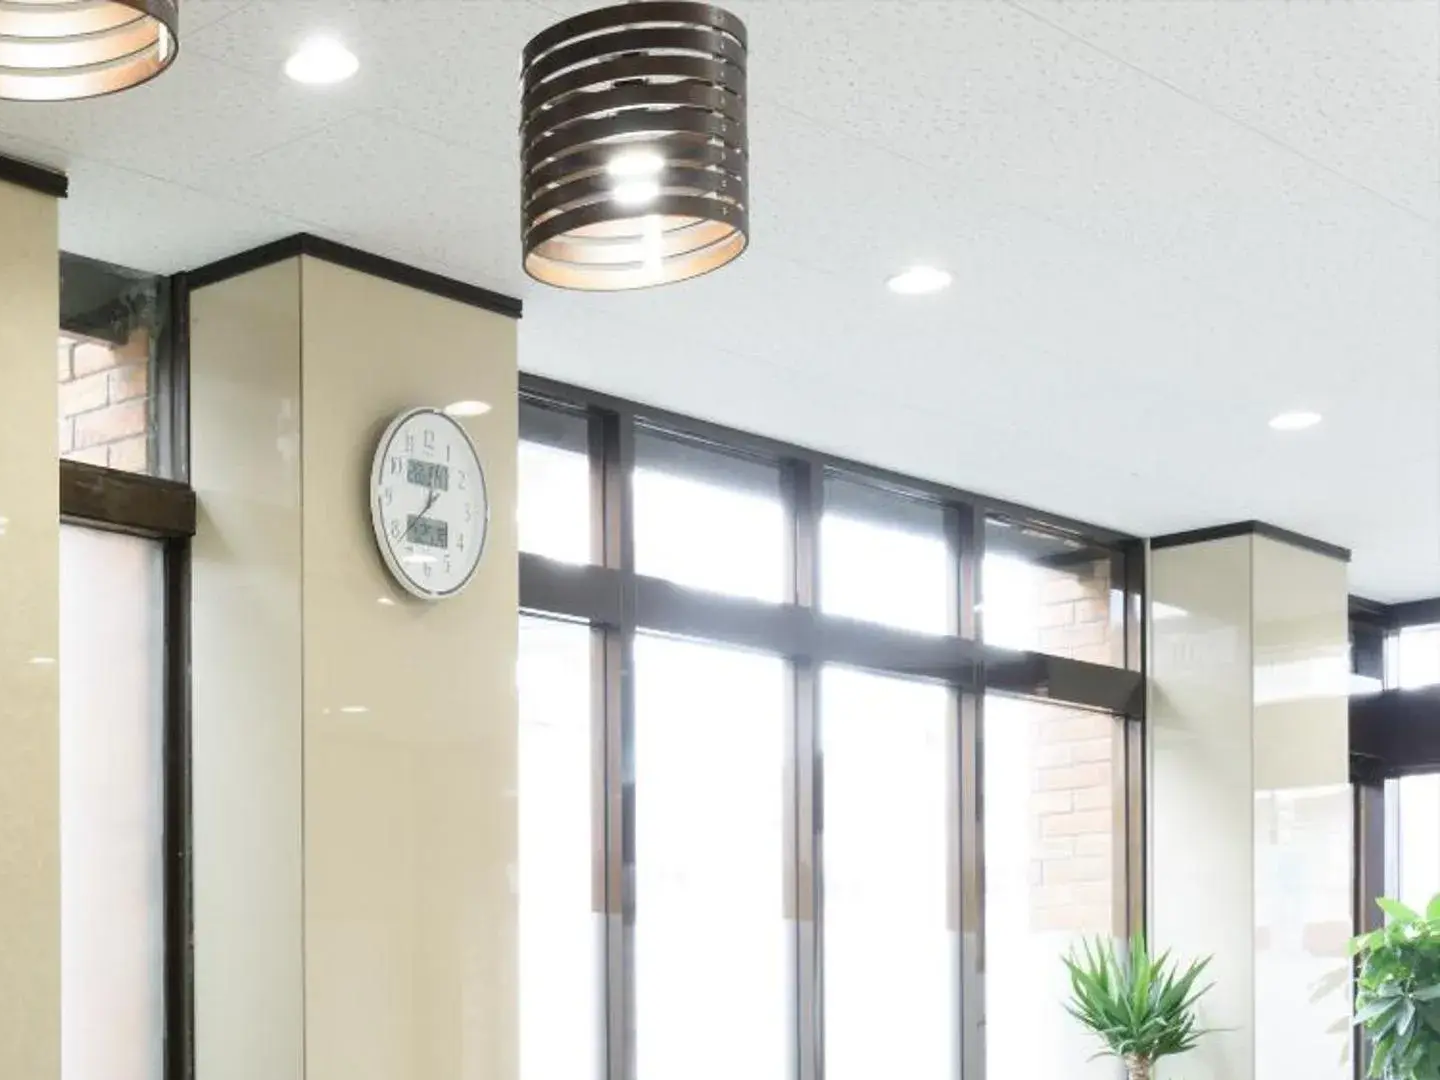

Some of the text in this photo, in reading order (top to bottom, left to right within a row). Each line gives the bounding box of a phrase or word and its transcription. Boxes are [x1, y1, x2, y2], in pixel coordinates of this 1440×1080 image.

[405, 431, 415, 453] 11
[424, 429, 435, 450] 12
[390, 456, 403, 475] 10
[457, 470, 466, 490] 2
[384, 487, 393, 506] 9
[464, 502, 472, 523] 3
[390, 519, 400, 538] 8
[456, 532, 464, 552] 4
[423, 561, 432, 578] 6
[444, 554, 451, 574] 5
